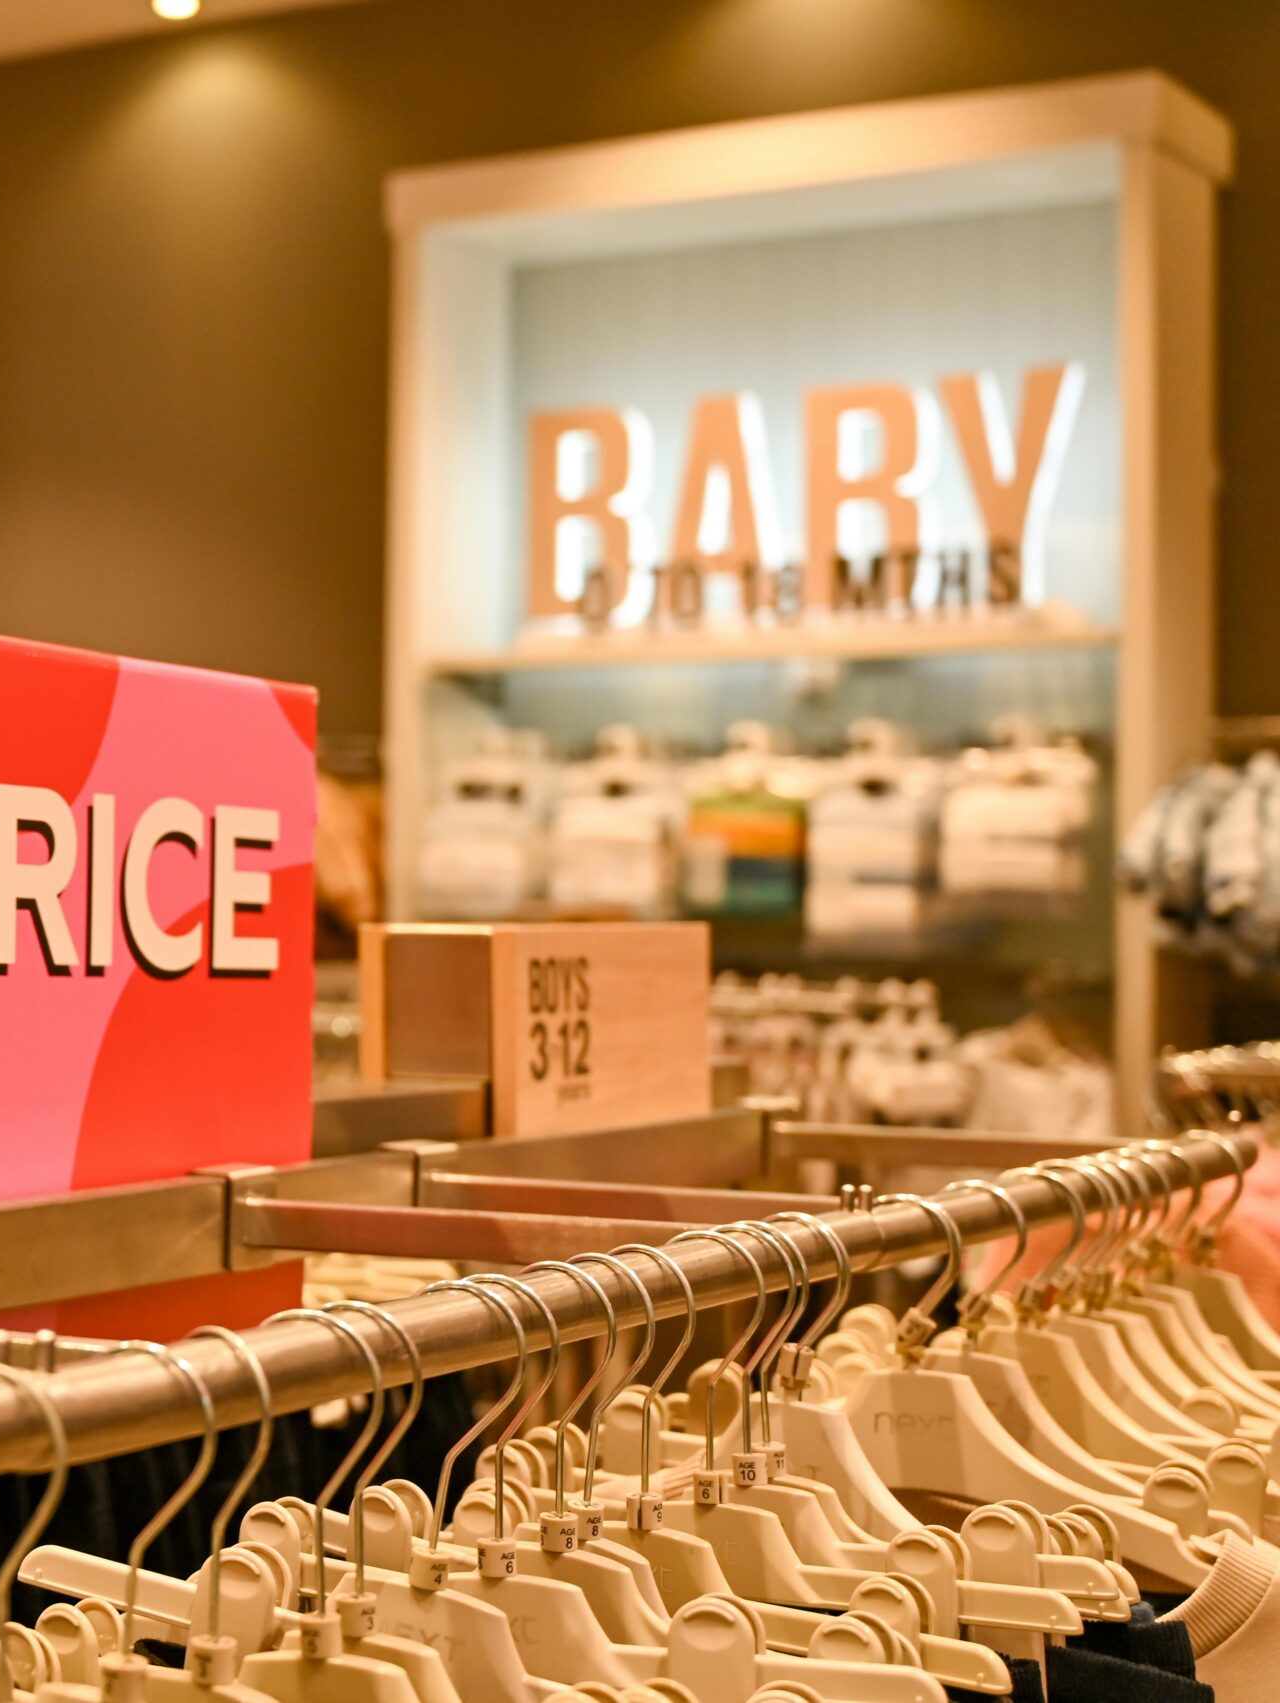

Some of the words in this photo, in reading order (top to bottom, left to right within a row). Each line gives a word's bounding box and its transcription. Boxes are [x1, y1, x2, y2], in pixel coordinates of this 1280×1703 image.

[528, 362, 1080, 620] BABY
[652, 564, 703, 622] TO
[834, 542, 1022, 614] MTHS
[529, 956, 590, 1015] BOYS
[738, 1461, 757, 1469] AGE
[739, 1469, 757, 1481] 10
[698, 1480, 715, 1488] AGE
[702, 1488, 711, 1500] 6
[586, 1516, 602, 1525] AGE
[560, 1527, 577, 1536] AGE
[591, 1525, 600, 1537] 8
[565, 1537, 574, 1549] 8
[501, 1552, 517, 1561] AGE
[430, 1564, 448, 1572] AGE
[505, 1561, 515, 1574] 6
[433, 1573, 443, 1585] 4
[365, 1616, 375, 1630] 3
